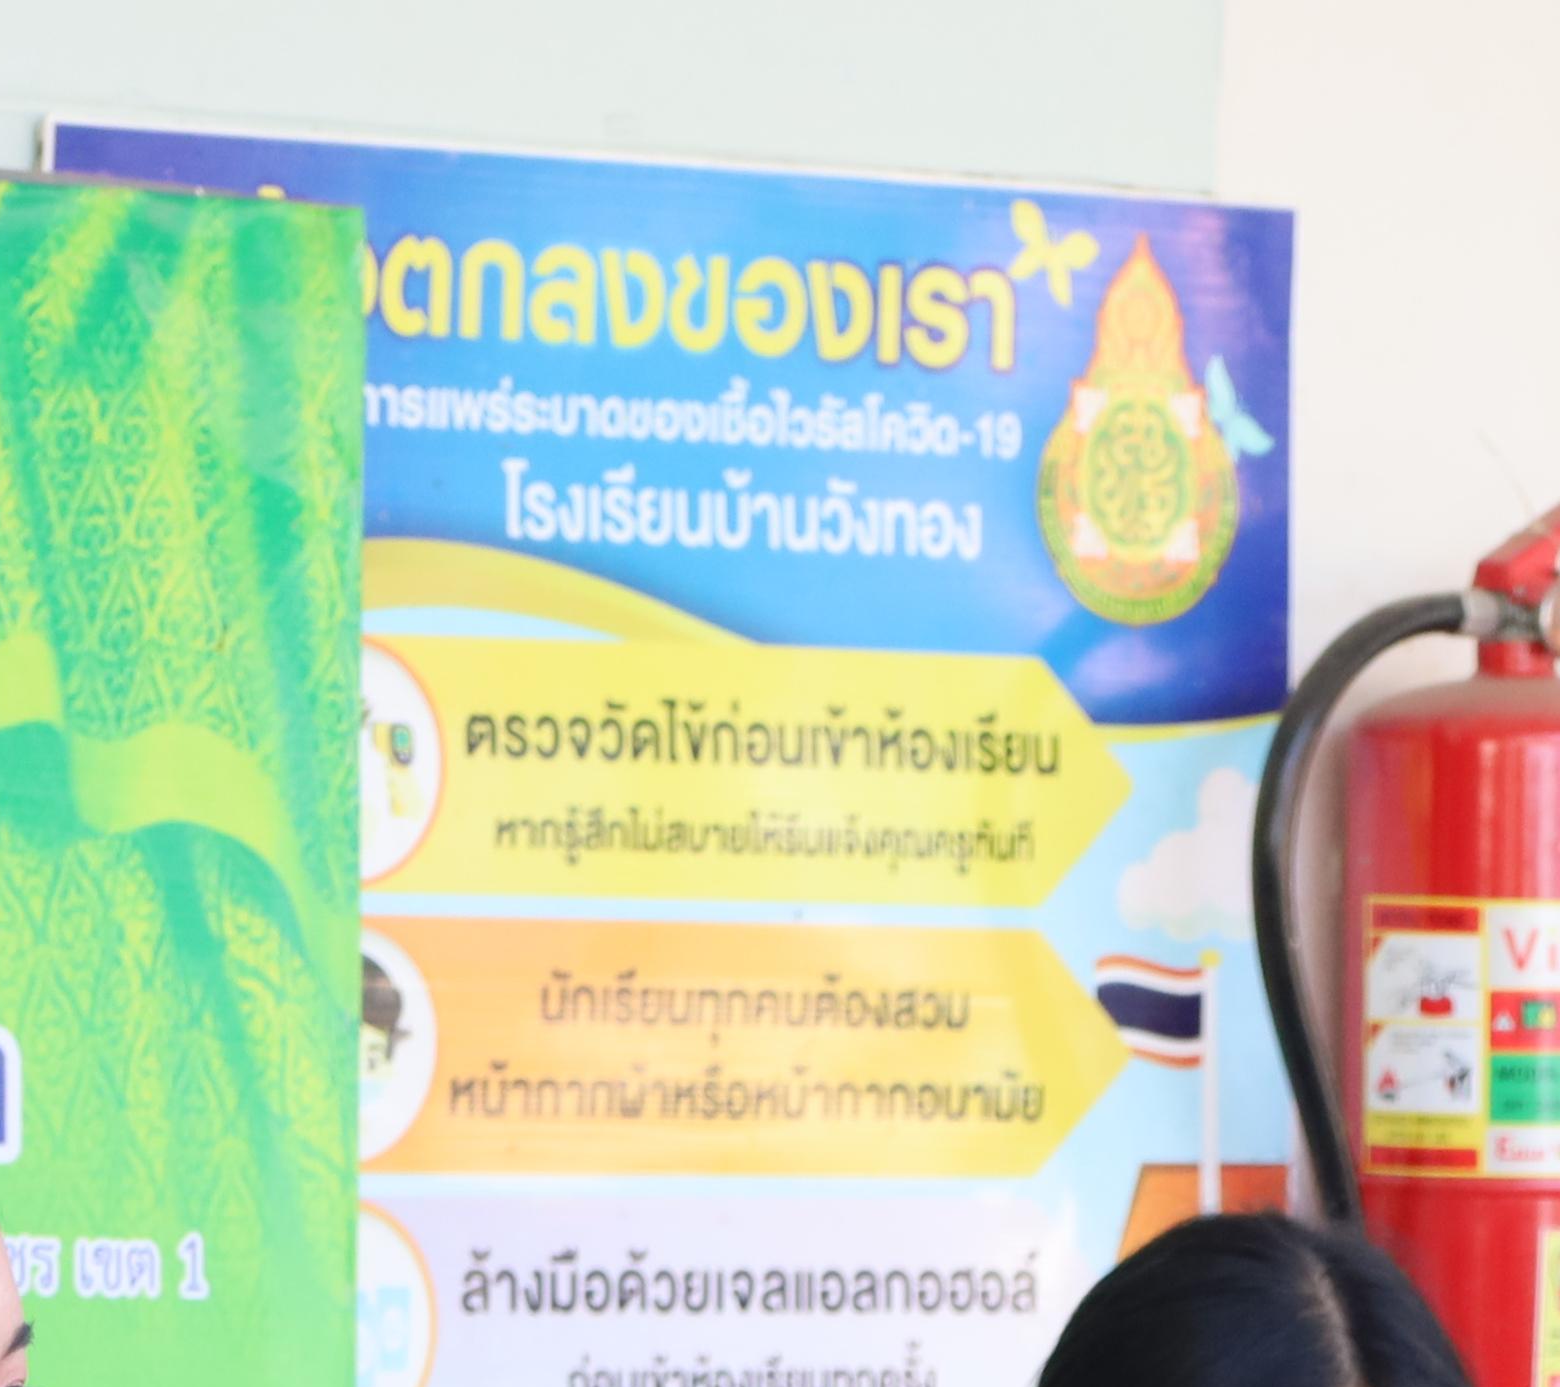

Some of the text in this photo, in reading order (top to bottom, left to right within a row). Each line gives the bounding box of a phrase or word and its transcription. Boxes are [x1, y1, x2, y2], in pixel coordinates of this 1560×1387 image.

[502, 457, 984, 562] โรงเรียนบ้านวังทอง
[465, 697, 1060, 777] ตรวจวัดไข้ก่อนเข้าห้องเรียน
[539, 968, 972, 1047] นักเรียนทุกคนต้องสวม
[448, 1060, 1047, 1126] หน้ากากผ้าหรือหน้ากากอนามัย
[5, 1239, 54, 1291] ชร
[78, 1242, 156, 1291] เขต
[183, 1236, 203, 1292] 1
[460, 1248, 1042, 1317] ล้างมือด้วยเจลแอลกอฮอล์
